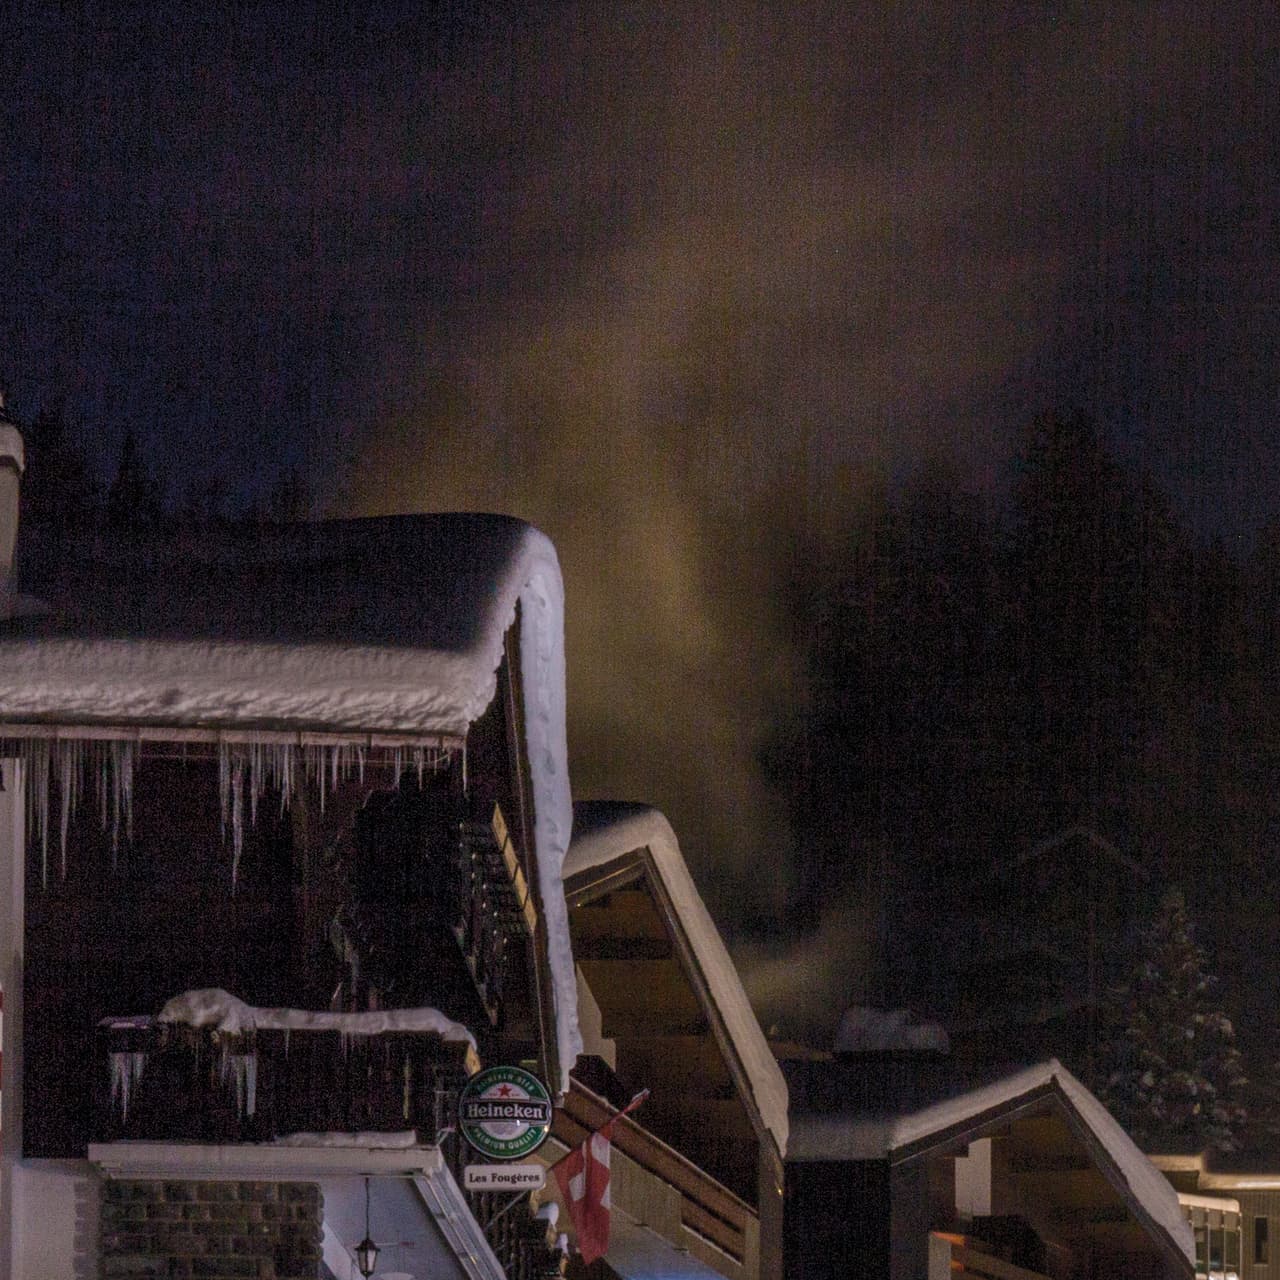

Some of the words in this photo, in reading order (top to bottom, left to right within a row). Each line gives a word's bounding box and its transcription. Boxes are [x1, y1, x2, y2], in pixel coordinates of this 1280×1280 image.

[468, 1104, 543, 1119] Heineken
[508, 1128, 538, 1150] QUALITY
[469, 1173, 487, 1183] Les
[491, 1173, 540, 1185] Fougères
